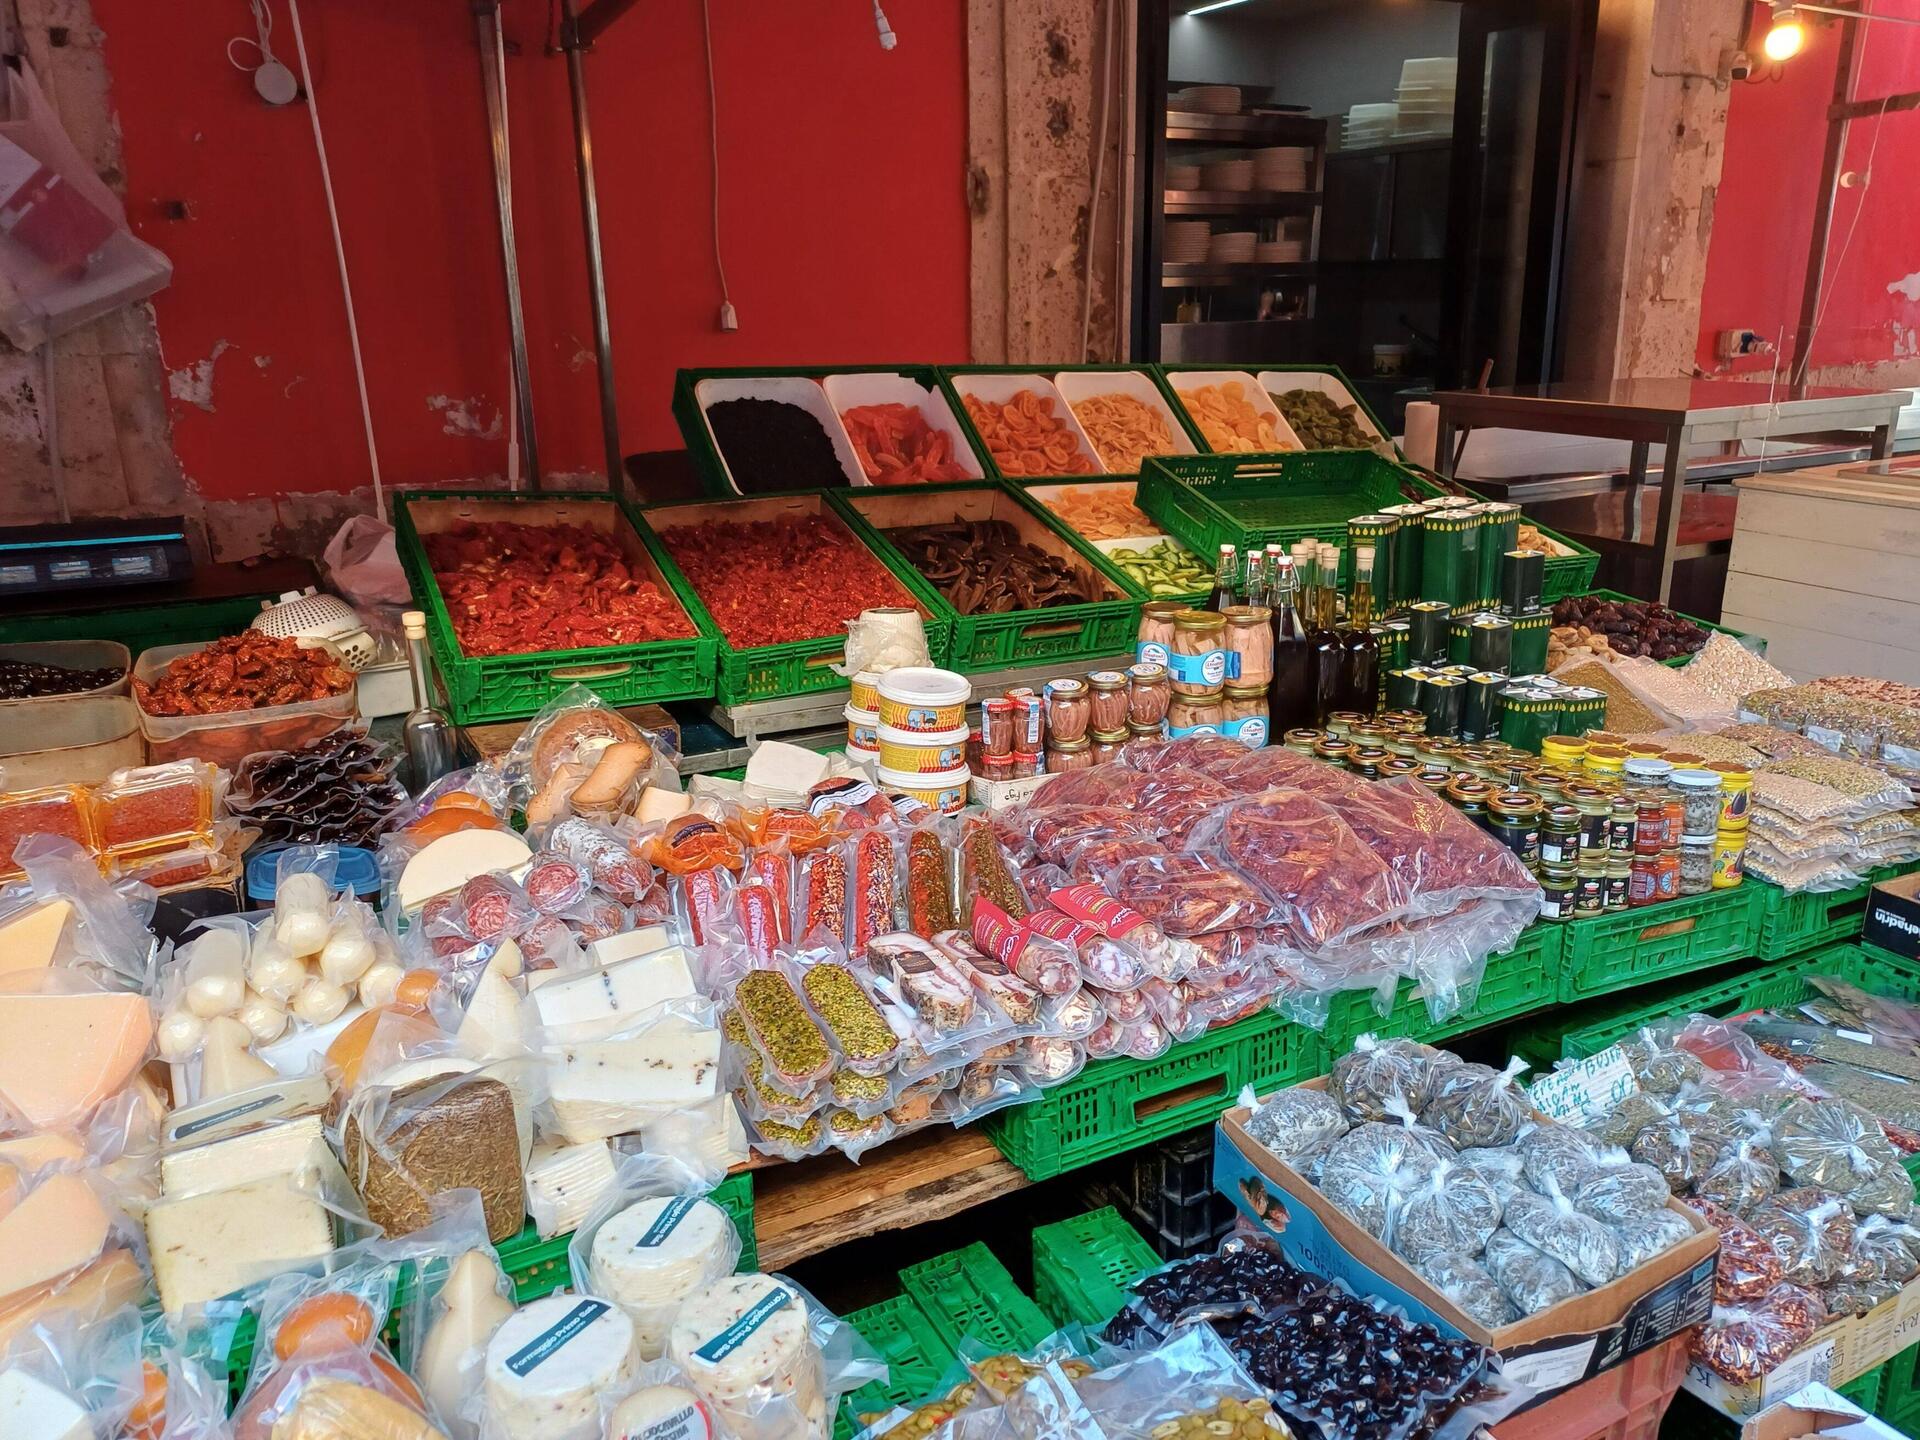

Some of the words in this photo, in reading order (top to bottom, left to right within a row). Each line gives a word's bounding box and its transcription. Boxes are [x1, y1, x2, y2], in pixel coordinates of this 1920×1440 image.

[1875, 911, 1920, 938] ehadrin
[659, 1216, 676, 1235] Primo
[1297, 1240, 1334, 1280] DJOOL
[746, 1291, 786, 1327] Formaggio
[511, 1333, 558, 1371] Formaggio
[554, 1315, 581, 1338] Primo
[578, 1302, 599, 1319] Sale
[728, 1324, 752, 1346] Primo
[1892, 1311, 1920, 1338] RAS
[710, 1342, 731, 1361] Sale
